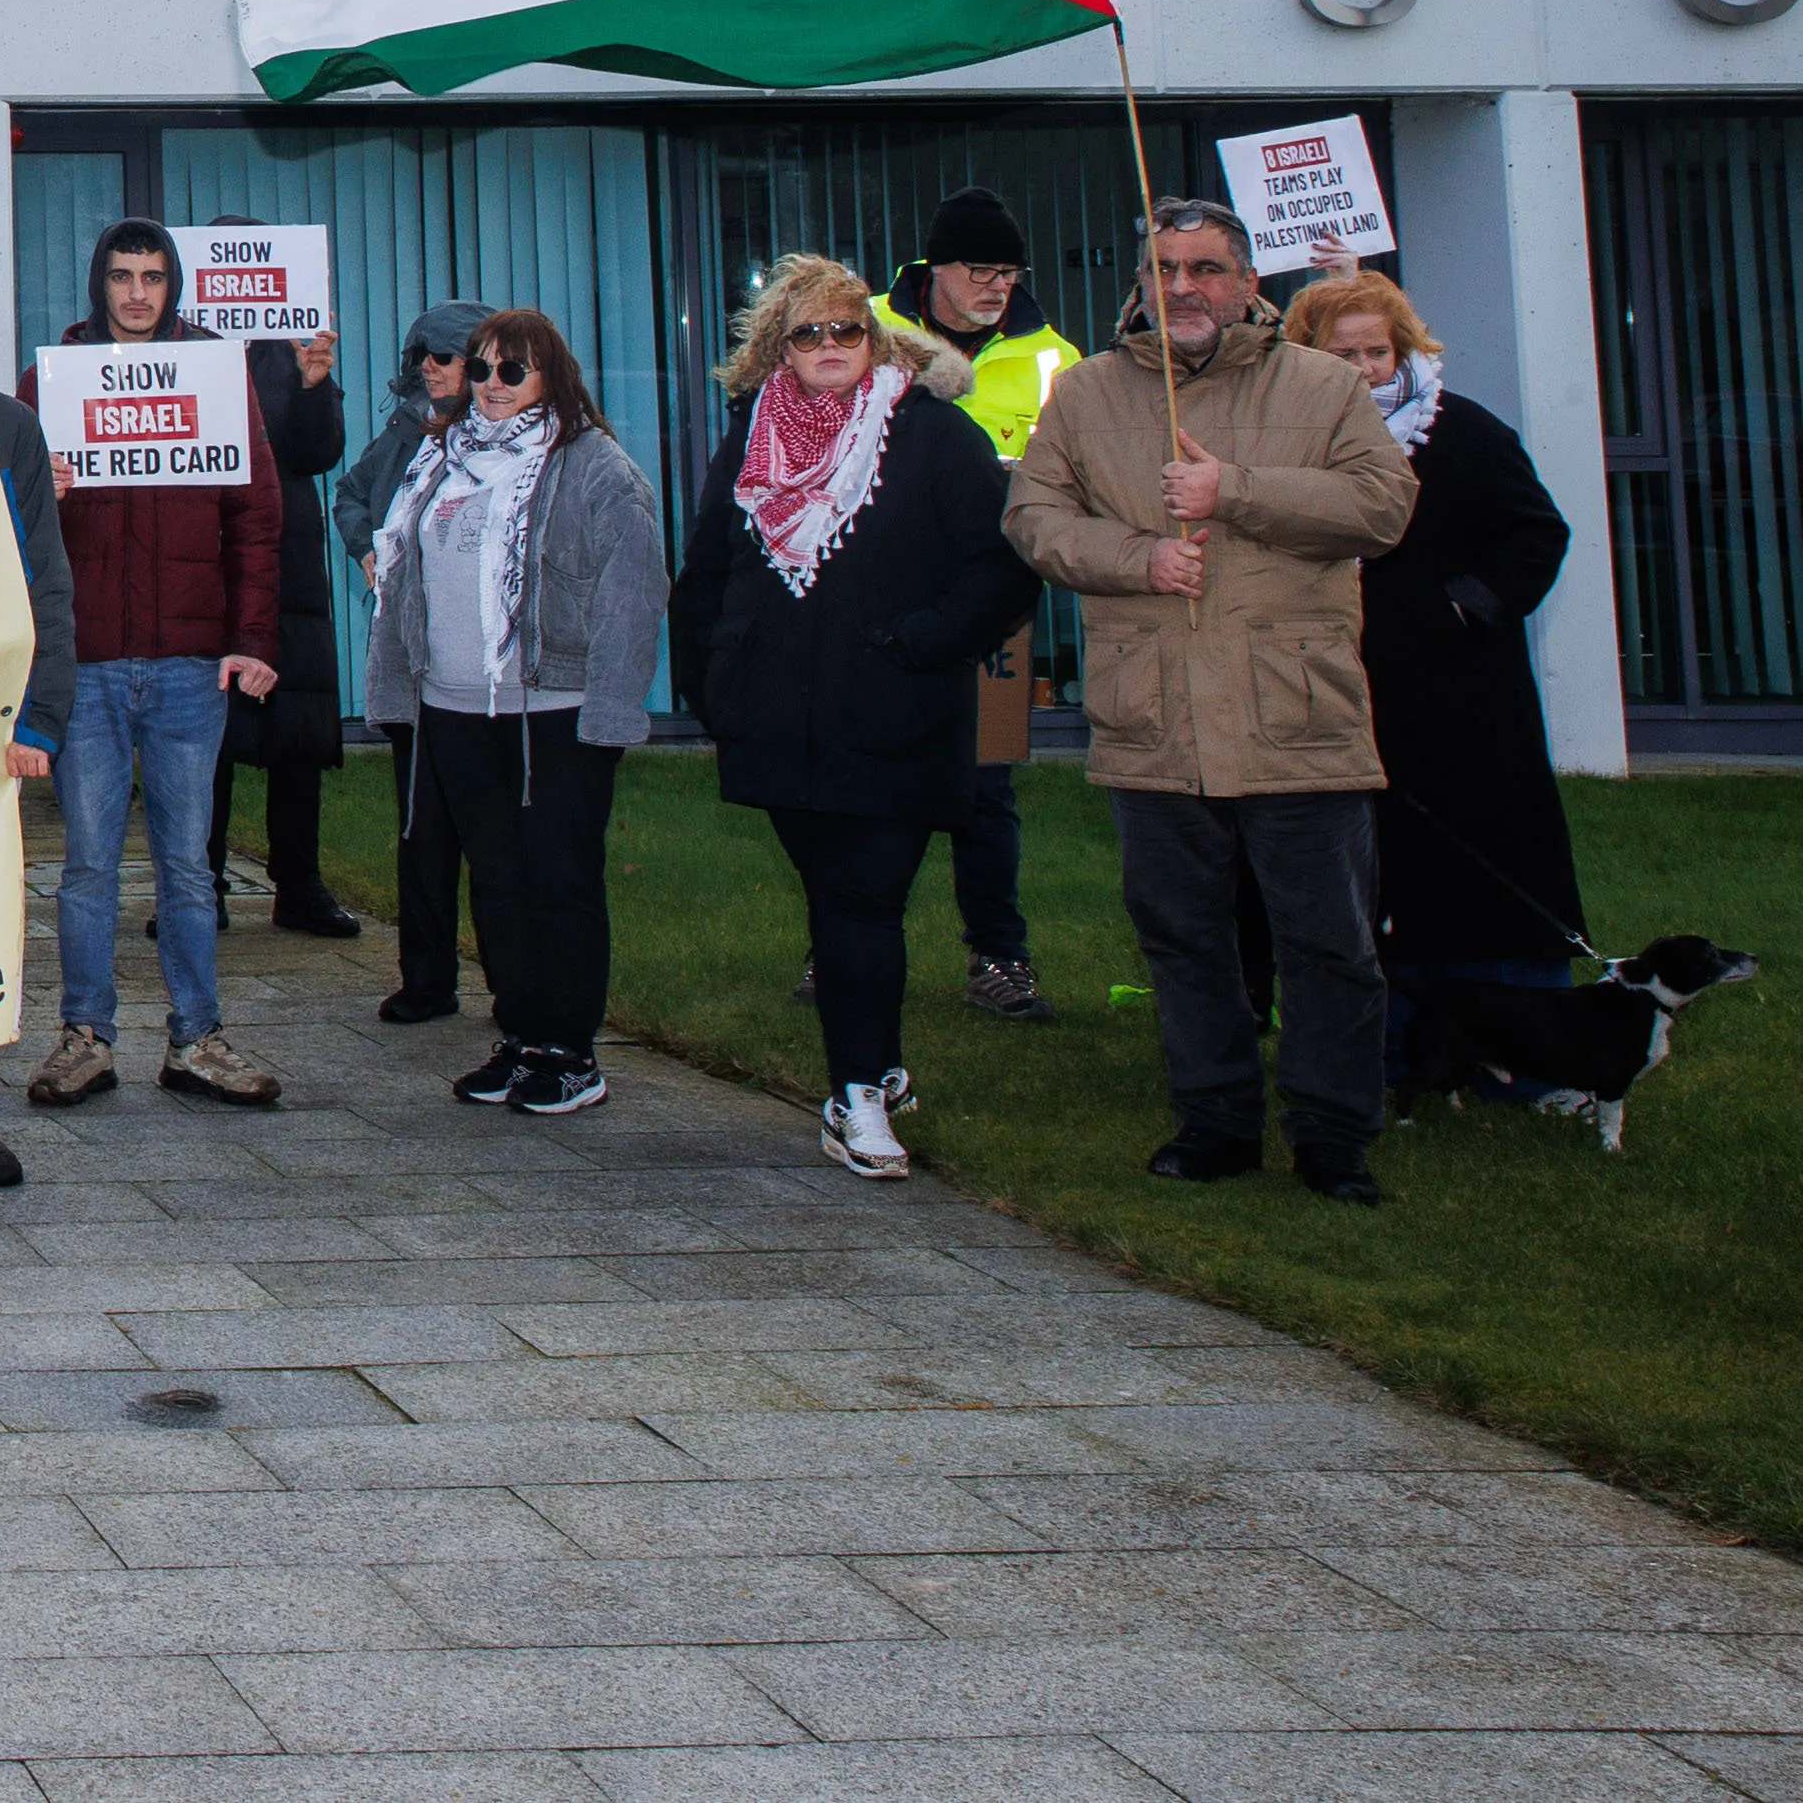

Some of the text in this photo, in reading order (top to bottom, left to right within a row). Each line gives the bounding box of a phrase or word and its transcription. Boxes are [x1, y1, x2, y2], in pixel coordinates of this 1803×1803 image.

[1265, 140, 1329, 168] 8 ISRAELI
[1264, 166, 1344, 197] TEAMS PLAY
[1266, 191, 1354, 223] ON OCCUPIED
[1343, 212, 1379, 236] LAND
[210, 241, 272, 263] SHOW
[204, 273, 281, 298] ISRAEL
[176, 307, 320, 330] HE RED CARD
[101, 362, 177, 392] SHOW
[95, 403, 191, 436] ISRAEL
[110, 448, 161, 477] RED
[170, 444, 240, 474] CARD
